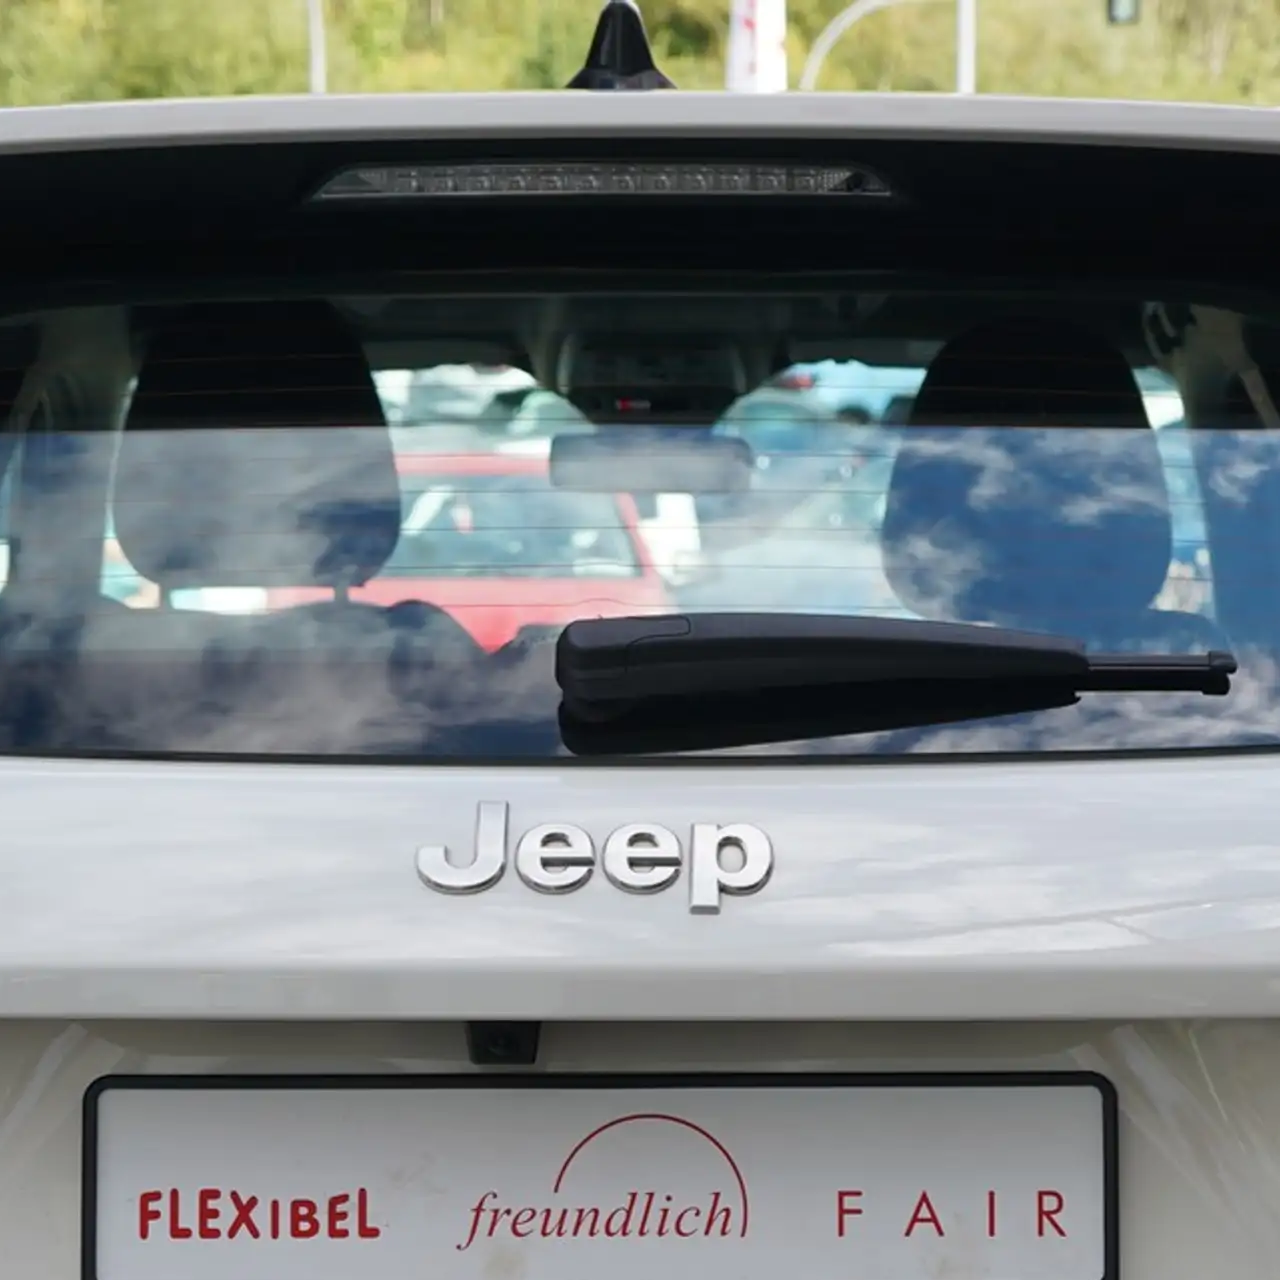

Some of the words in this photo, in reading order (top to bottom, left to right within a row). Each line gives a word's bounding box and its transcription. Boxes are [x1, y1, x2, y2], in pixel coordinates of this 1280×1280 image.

[416, 800, 774, 915] Jeep
[139, 1188, 380, 1240] FLEXIBEL
[456, 1191, 733, 1251] freundlich
[837, 1190, 1067, 1237] FAIR
